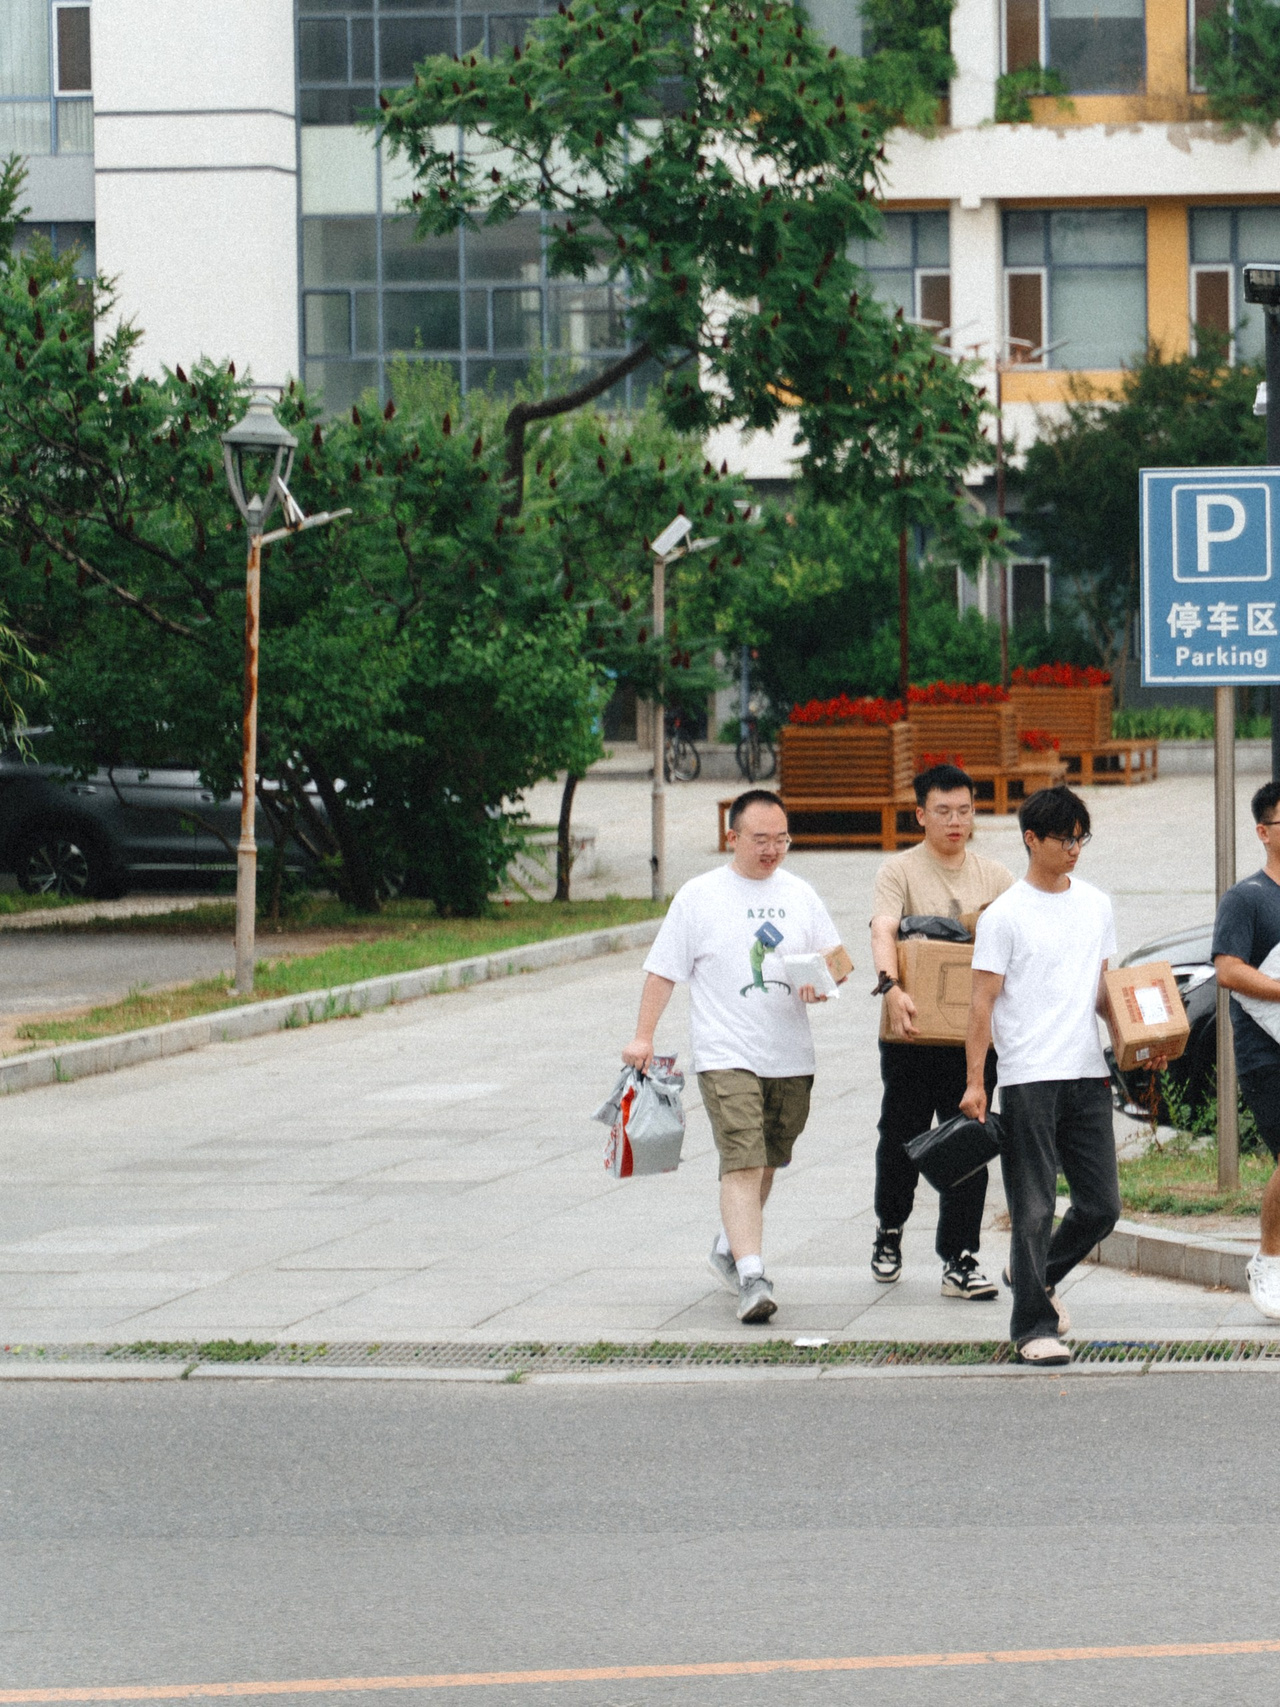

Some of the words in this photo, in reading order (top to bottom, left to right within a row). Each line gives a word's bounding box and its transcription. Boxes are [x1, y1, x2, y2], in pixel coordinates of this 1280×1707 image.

[1196, 494, 1246, 572] P
[1166, 601, 1278, 638] 停车区
[1175, 646, 1268, 668] Parking
[747, 907, 786, 919] AZCO
